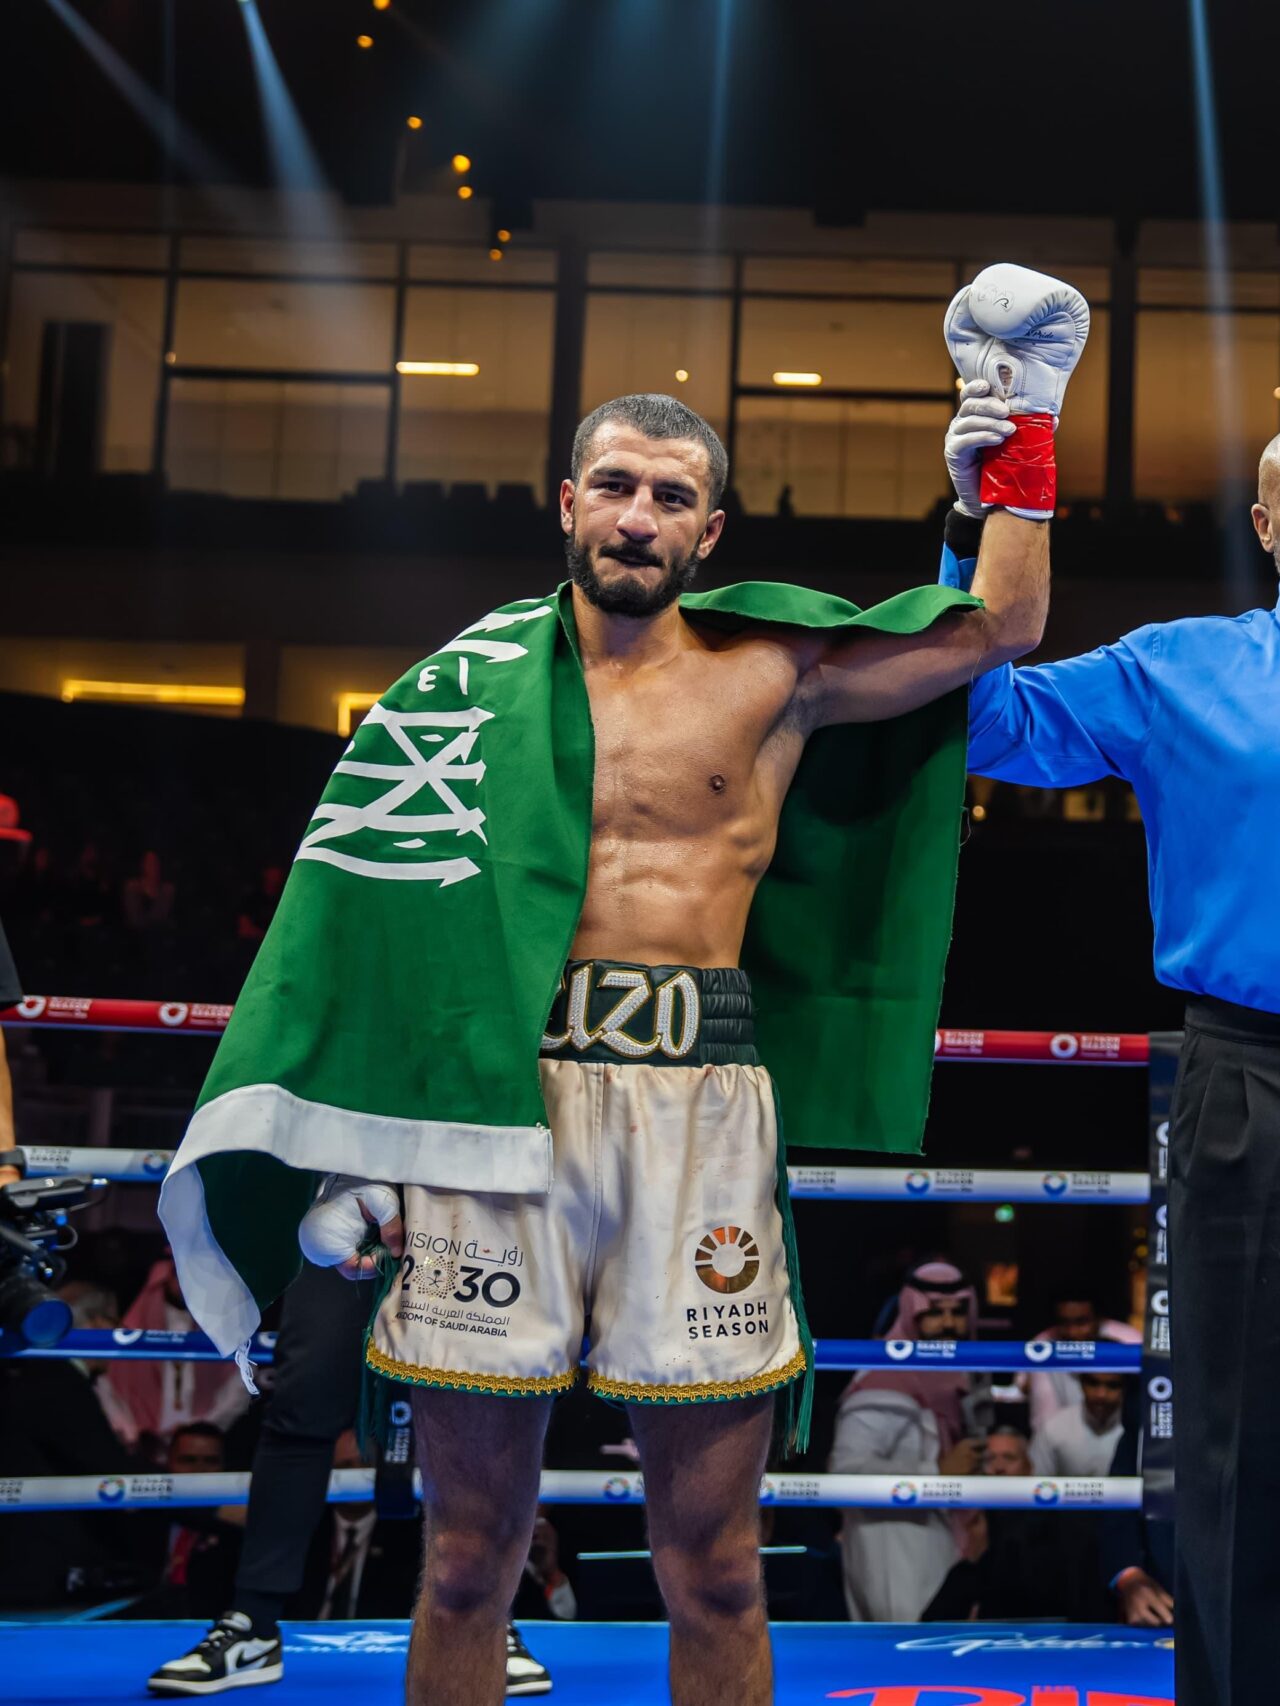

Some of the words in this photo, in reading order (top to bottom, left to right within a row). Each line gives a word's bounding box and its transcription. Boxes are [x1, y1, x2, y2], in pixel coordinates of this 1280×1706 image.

[464, 1240, 524, 1267] رؤية
[431, 1305, 464, 1320] العربية
[466, 1310, 511, 1326] المملكة
[686, 1301, 767, 1322] RIYADH
[424, 1316, 439, 1327] OF
[439, 1320, 469, 1333] SAUDI
[468, 1325, 509, 1338] ARABIA
[688, 1320, 769, 1340] SEASON
